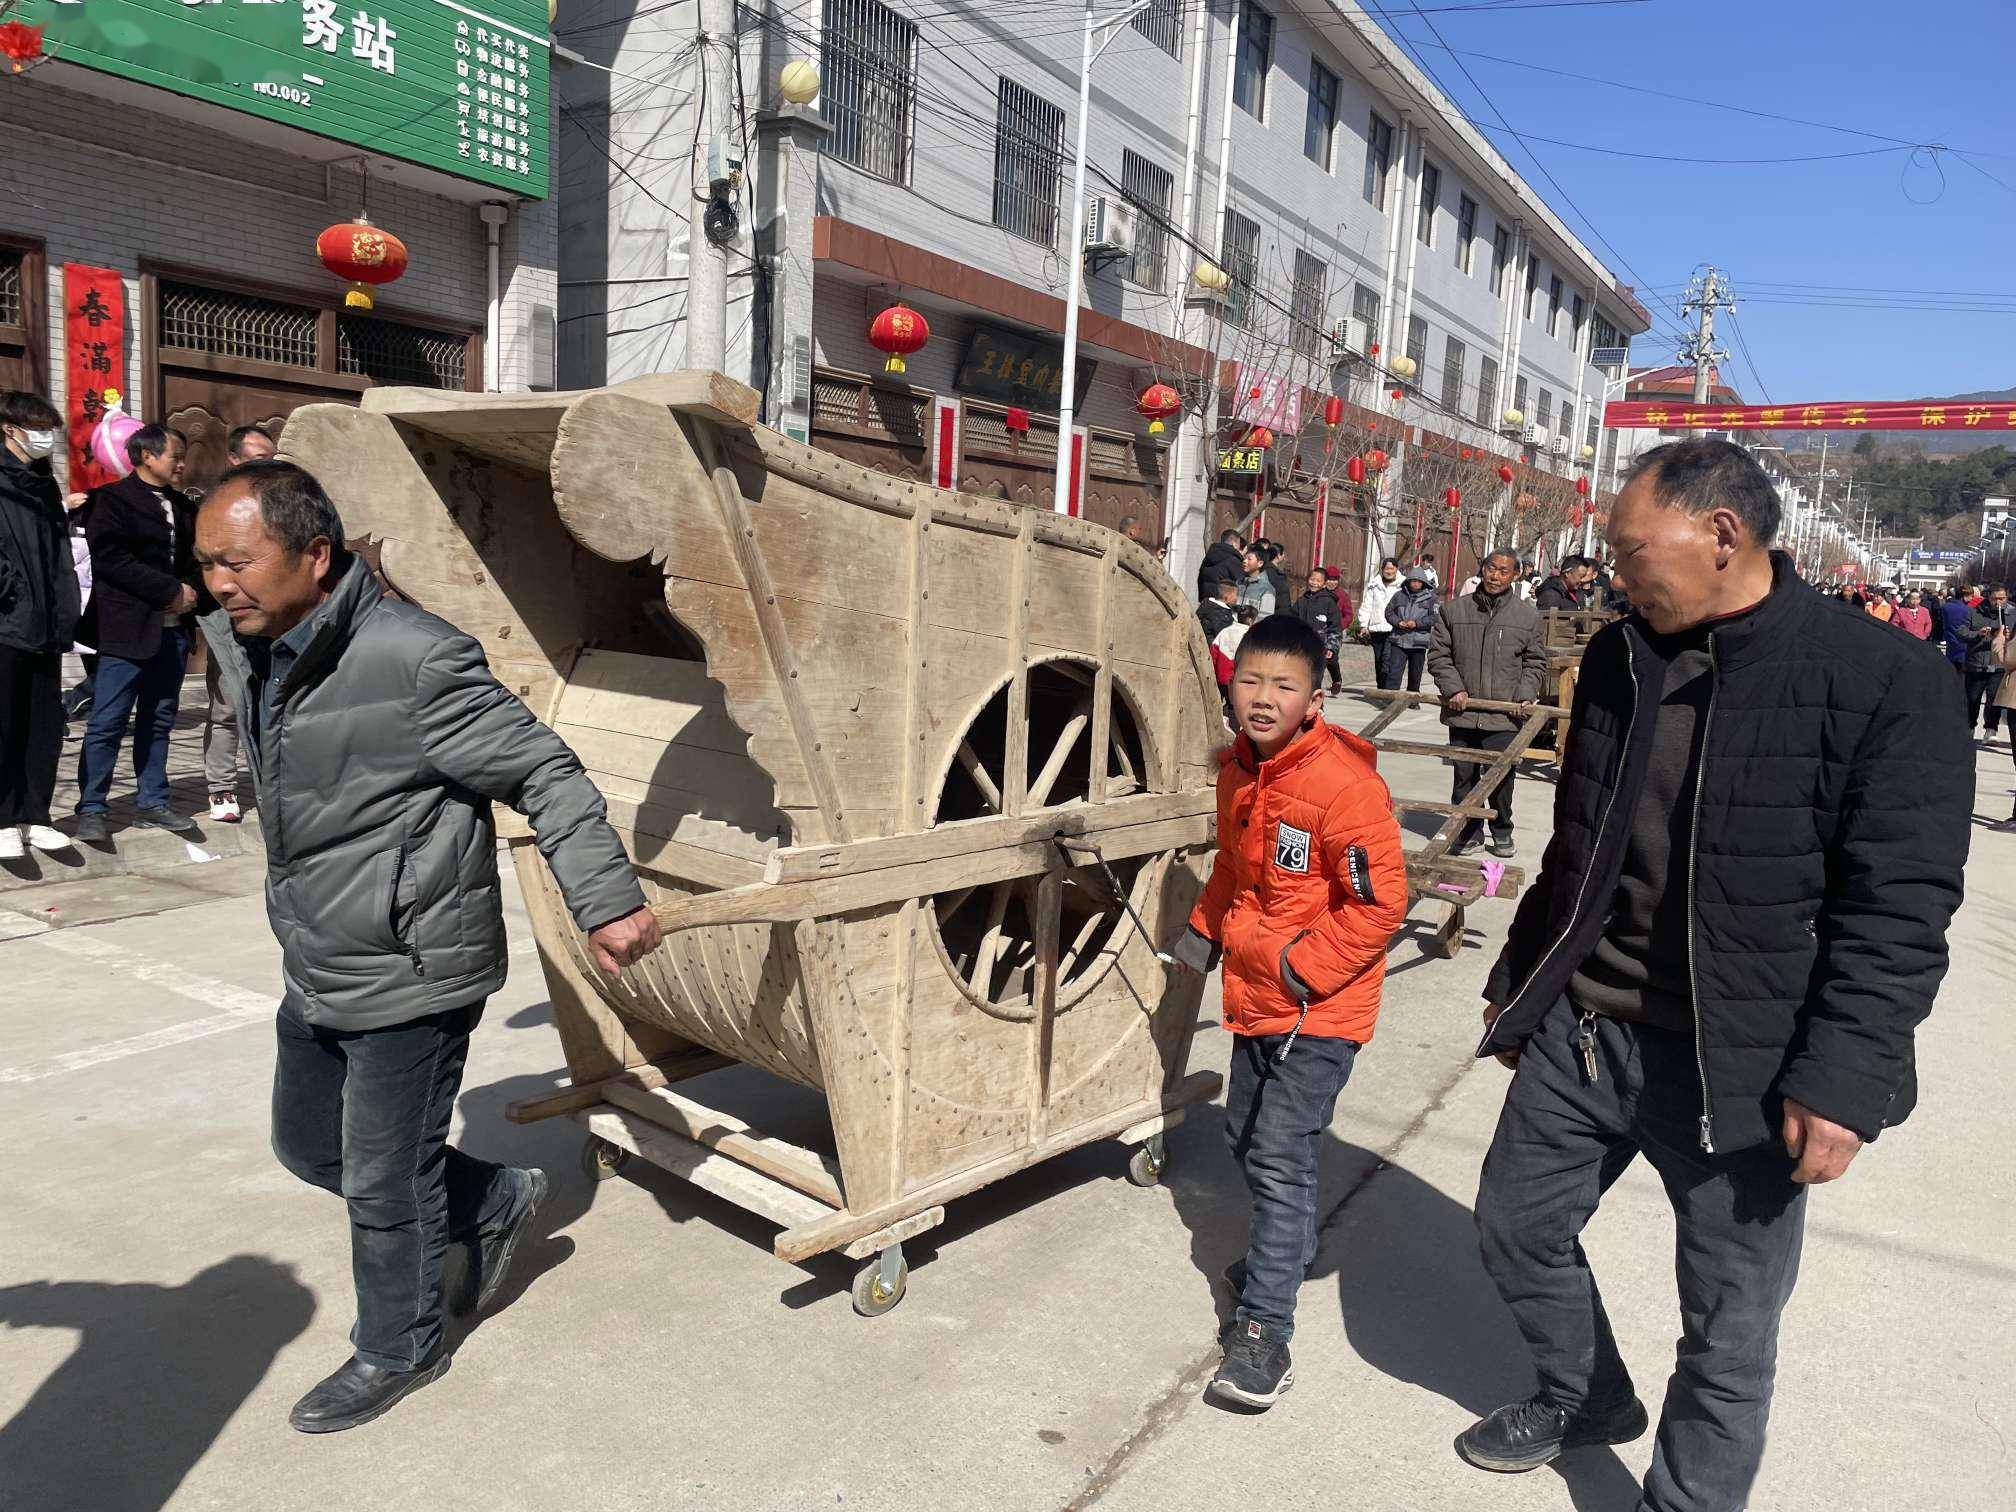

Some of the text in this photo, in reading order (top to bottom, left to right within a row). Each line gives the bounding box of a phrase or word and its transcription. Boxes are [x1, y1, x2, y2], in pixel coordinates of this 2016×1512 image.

[477, 27, 529, 60] 代买代卖
[476, 47, 529, 79] 物流服务
[476, 68, 529, 98] 金融服务
[477, 87, 529, 118] 便民服务
[477, 106, 529, 137] 培训服务
[477, 127, 529, 157] 旅游服务
[477, 147, 530, 175] 农资服务
[1280, 844, 1305, 867] 79
